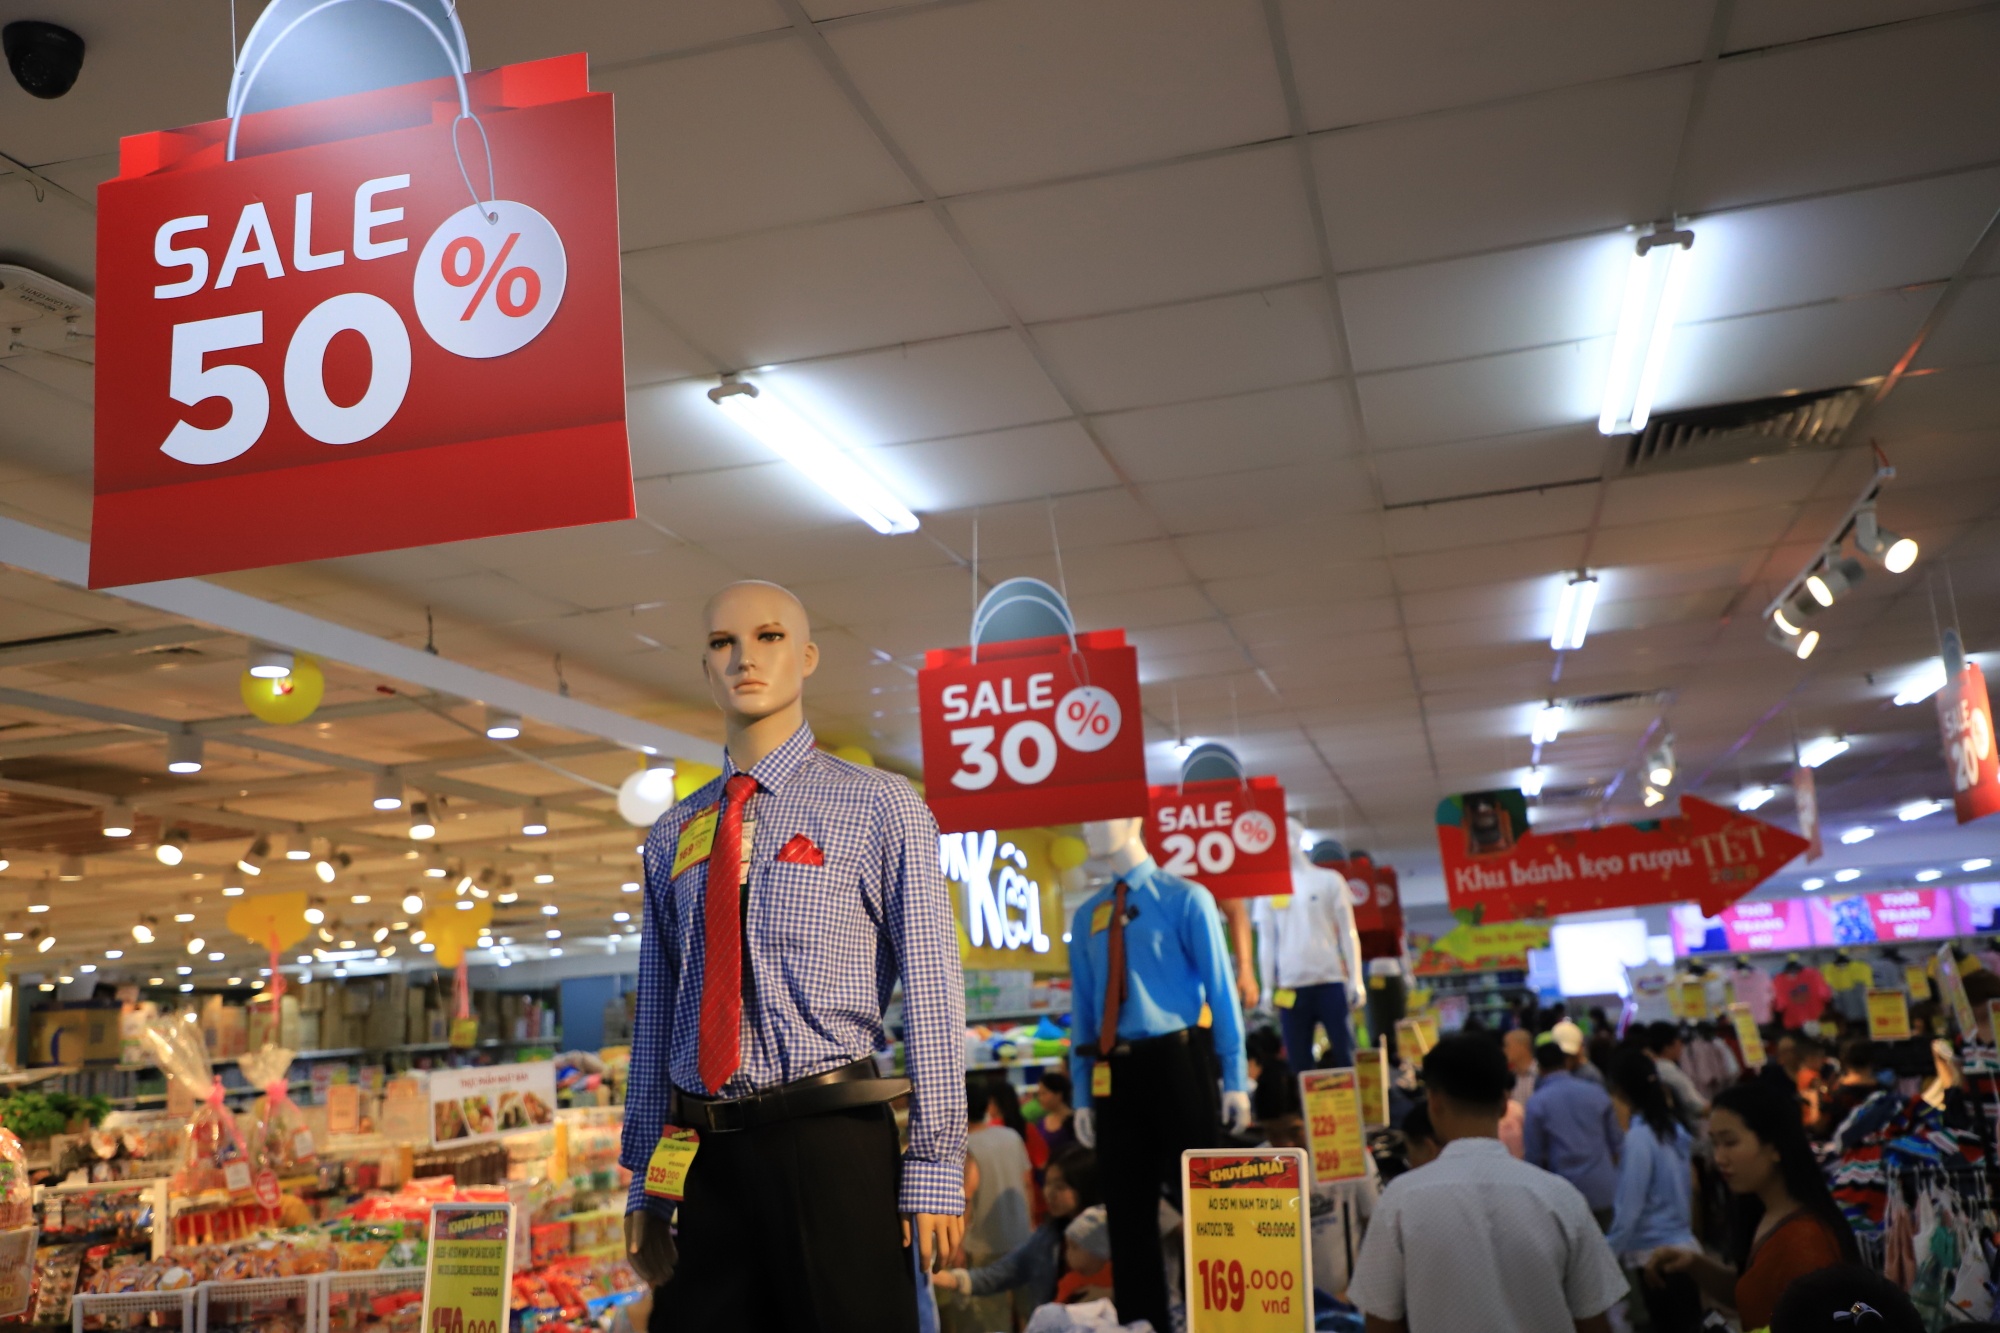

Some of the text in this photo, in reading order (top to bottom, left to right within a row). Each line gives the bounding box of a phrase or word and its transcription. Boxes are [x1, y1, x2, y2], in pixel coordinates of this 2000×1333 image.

[153, 173, 410, 299] SALE
[941, 672, 1054, 722] SALE
[1157, 801, 1233, 832] SALE
[1454, 863, 1508, 893] Khu
[1509, 854, 1575, 887] bánh
[1577, 852, 1624, 881] kẹo
[1210, 1161, 1258, 1182] KHUYẾN
[1239, 1198, 1254, 1210] NAM
[447, 1212, 486, 1234] KHUYẾN
